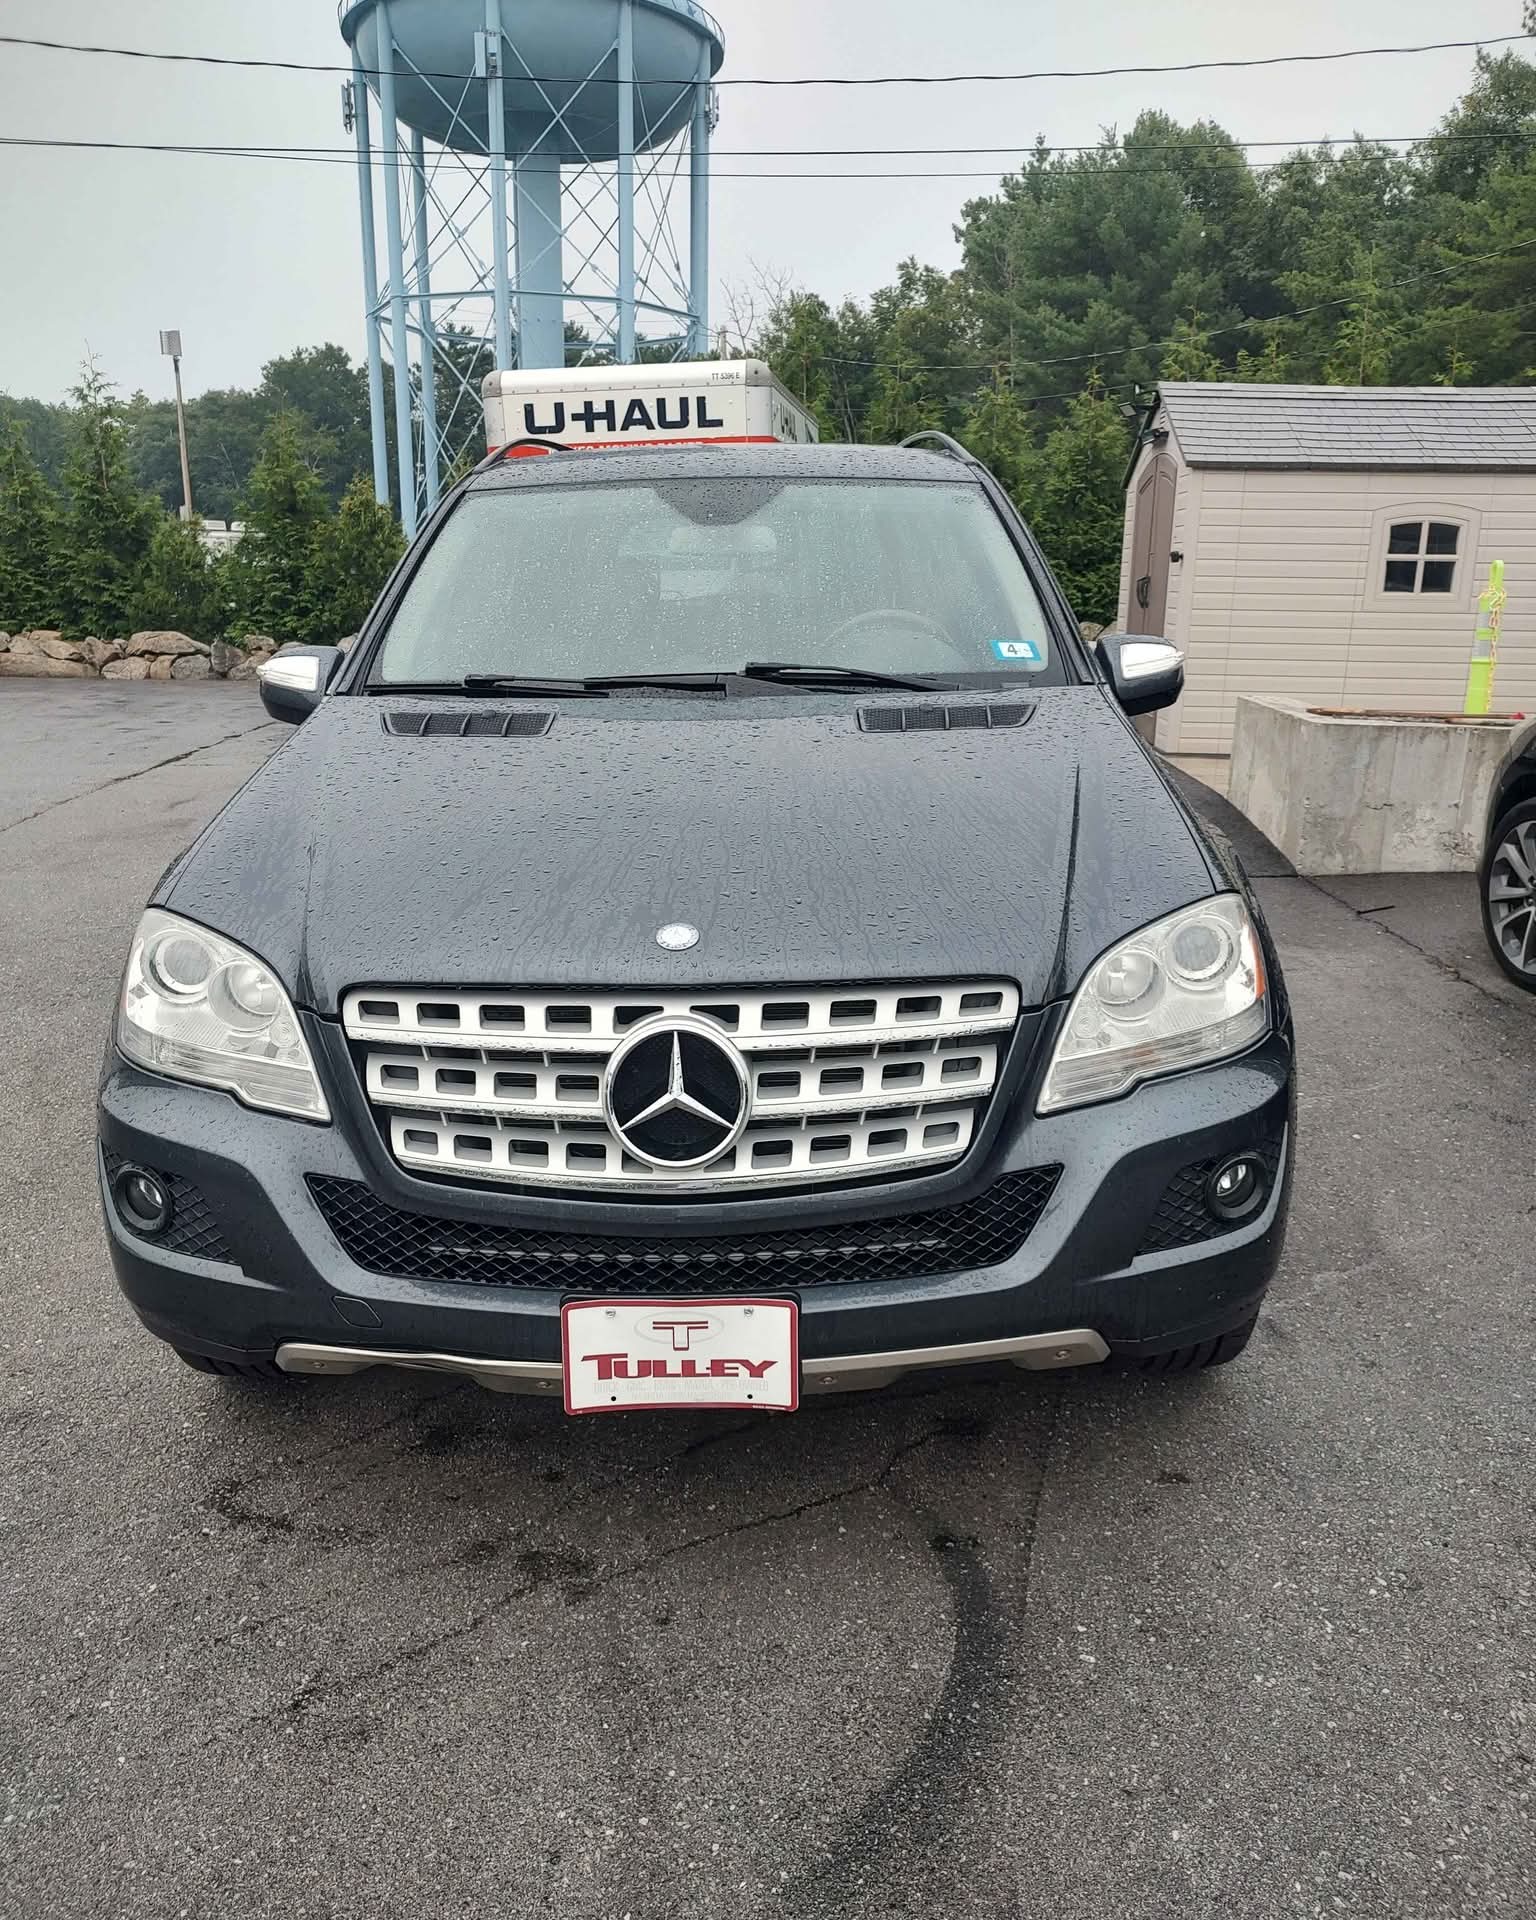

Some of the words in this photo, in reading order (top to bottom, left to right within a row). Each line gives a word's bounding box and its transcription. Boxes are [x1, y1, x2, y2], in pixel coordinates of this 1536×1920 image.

[523, 396, 724, 435] U-HAUL
[1007, 644, 1018, 655] 4
[581, 1353, 778, 1380] TULLEY
